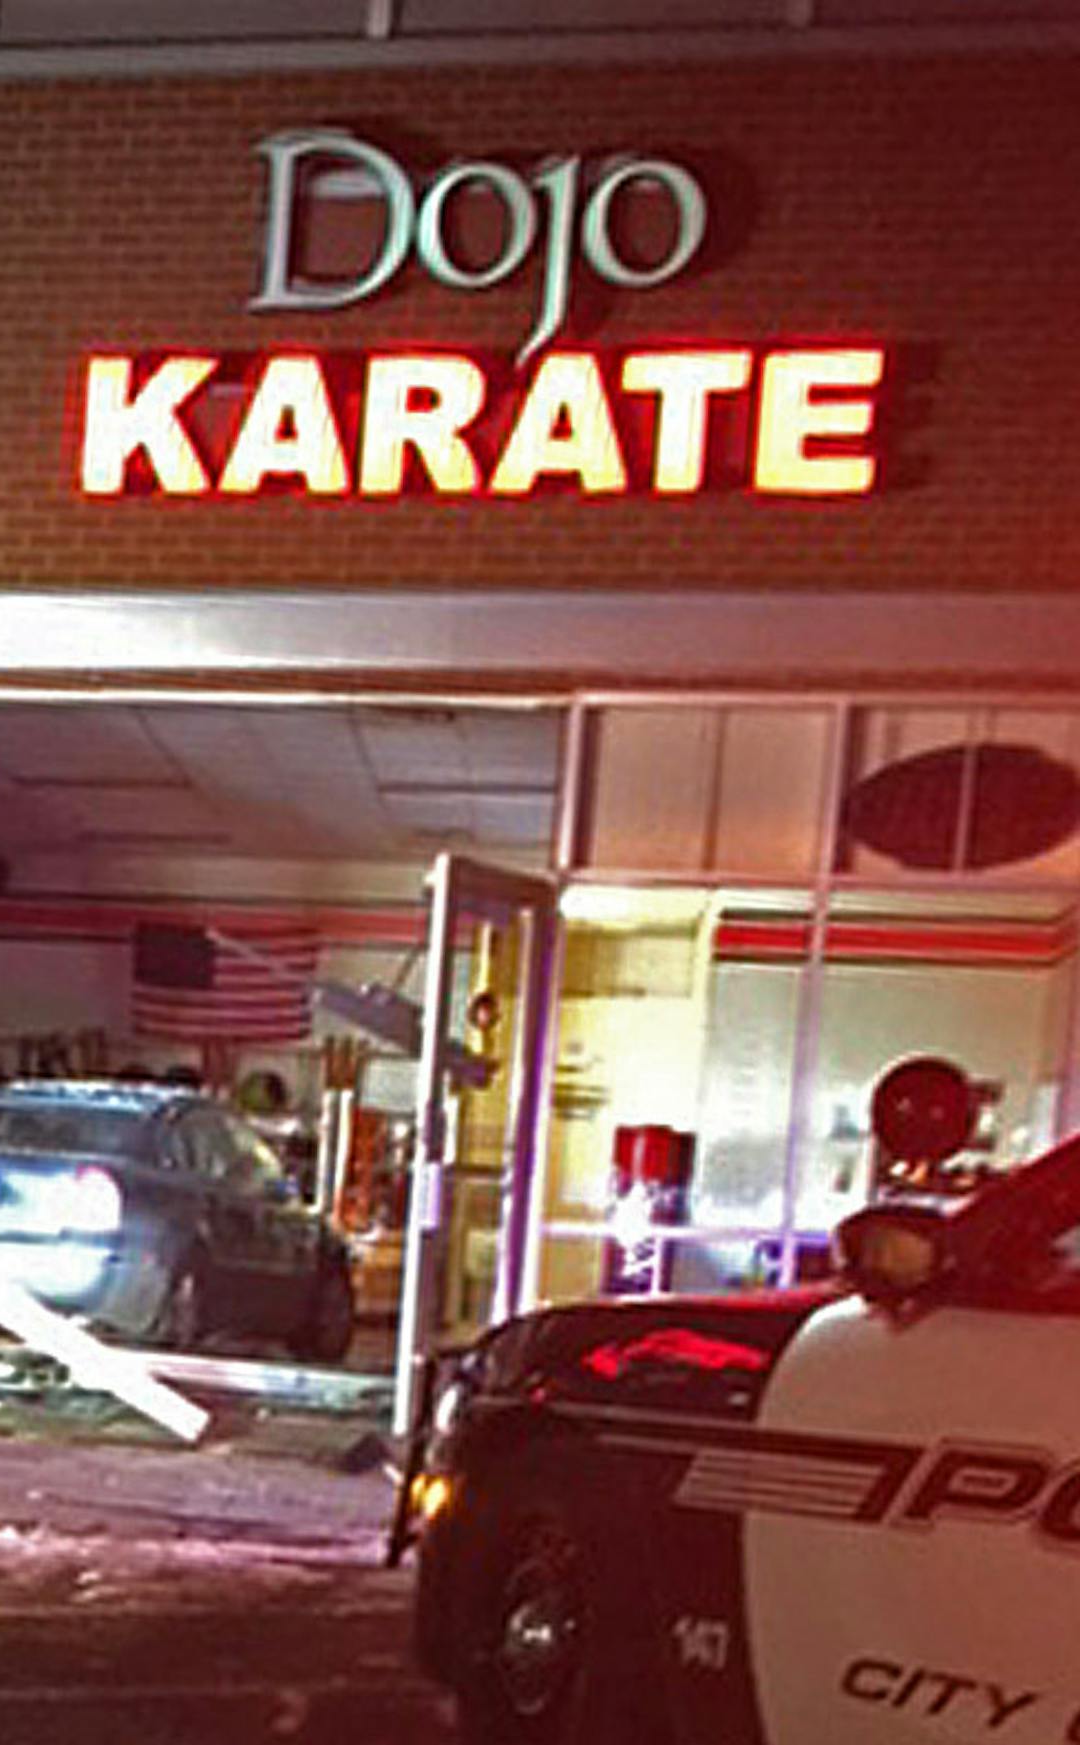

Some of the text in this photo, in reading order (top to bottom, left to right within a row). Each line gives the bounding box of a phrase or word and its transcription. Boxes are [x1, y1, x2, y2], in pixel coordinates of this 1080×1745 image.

[248, 128, 708, 366] Dojo
[78, 347, 885, 496] KARATE
[841, 1658, 1038, 1729] CITY
